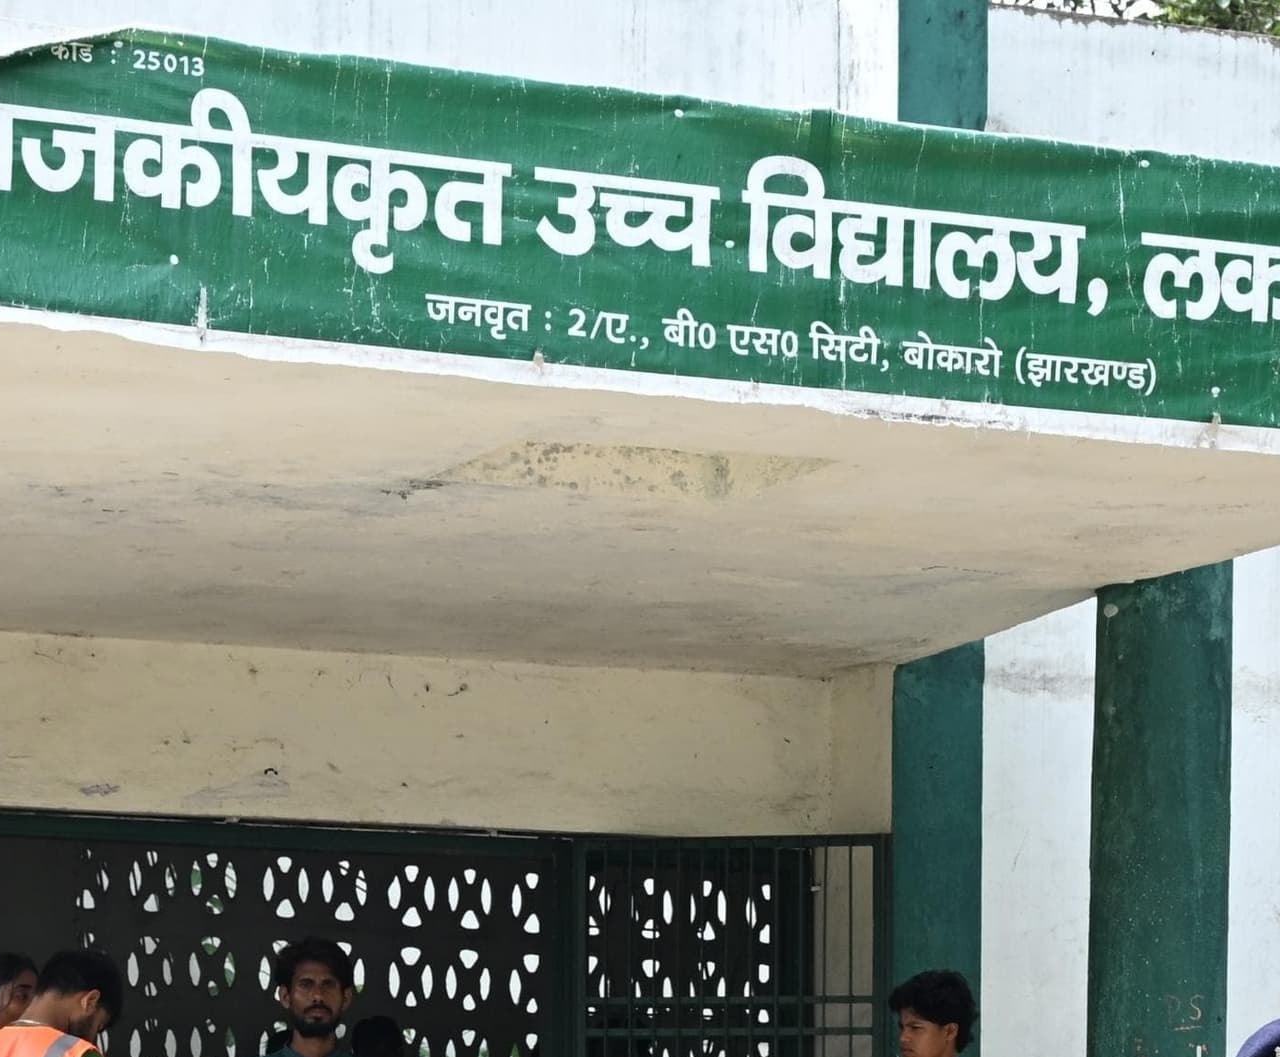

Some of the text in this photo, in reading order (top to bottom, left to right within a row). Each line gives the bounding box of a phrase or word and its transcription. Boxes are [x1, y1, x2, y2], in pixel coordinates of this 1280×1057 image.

[132, 49, 206, 77] 25013
[535, 167, 720, 271] उच्च
[742, 156, 1110, 316] विद्यालय,
[425, 293, 531, 339] जनवृत
[809, 320, 890, 372] सिटी,
[902, 330, 1003, 377] बोकारो
[1015, 346, 1157, 396] (झारखण्ड)
